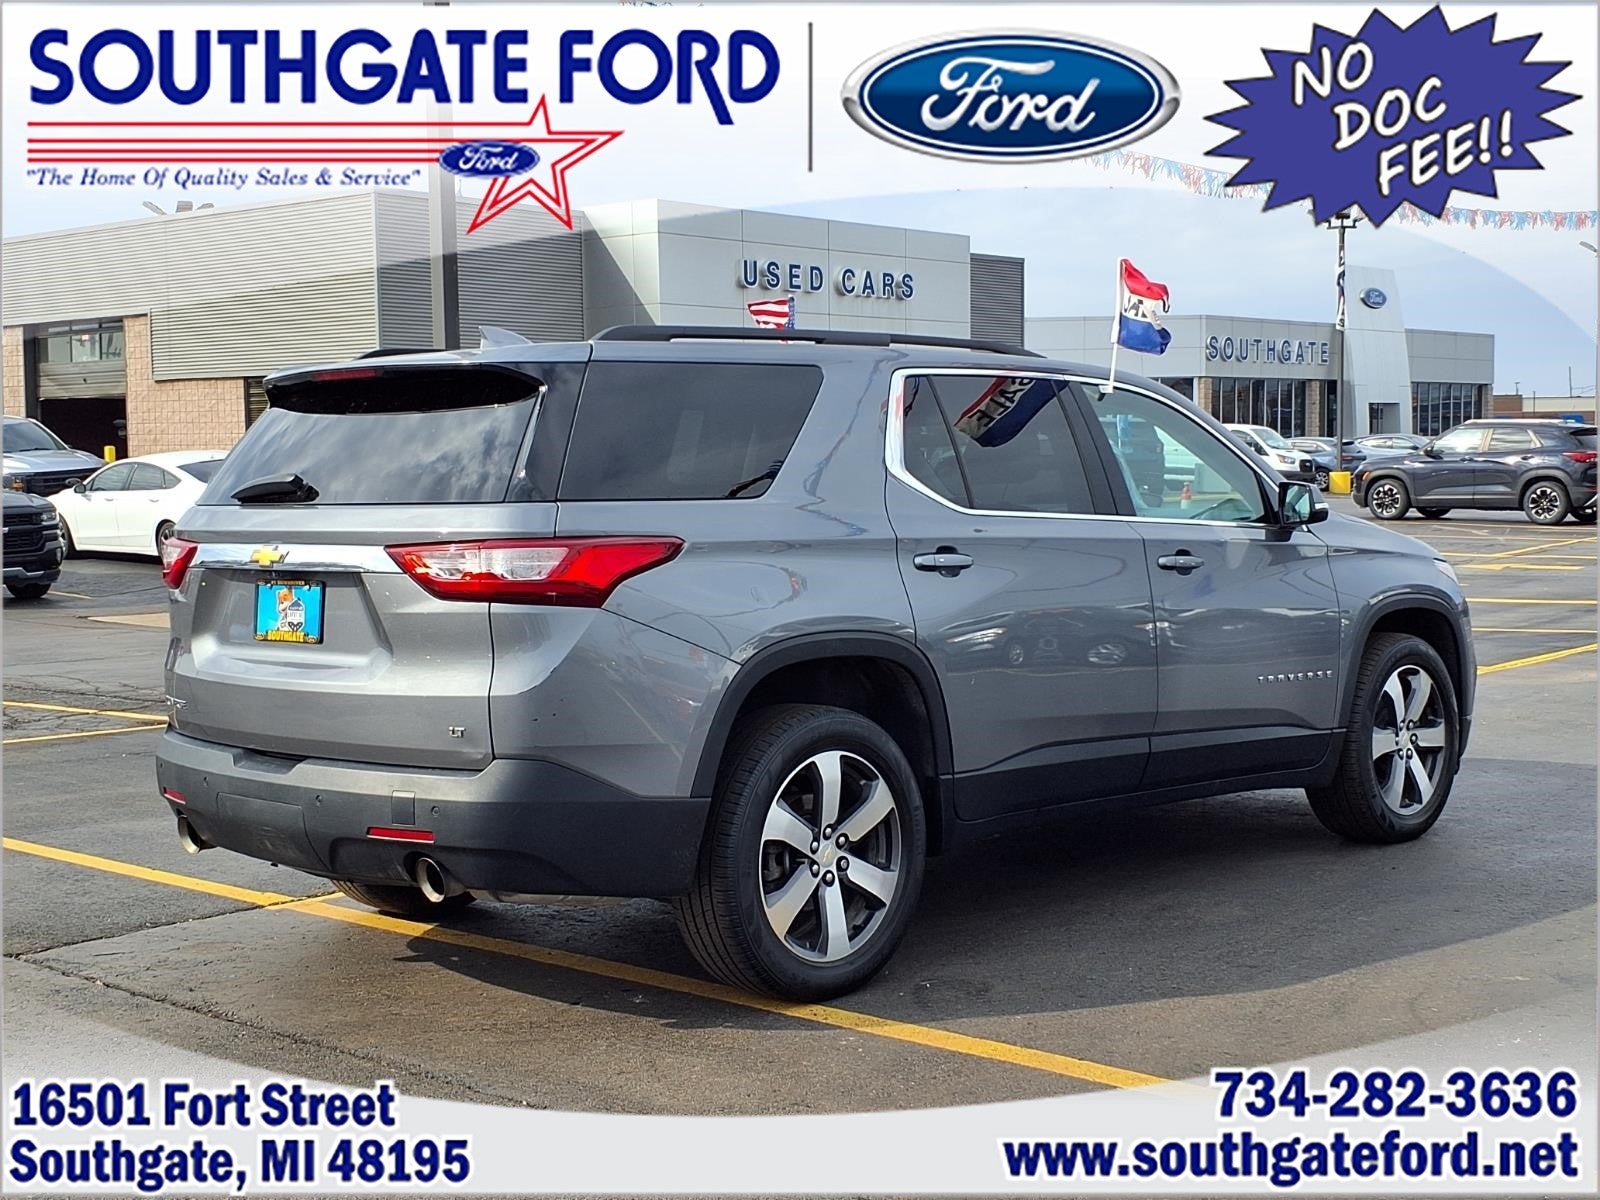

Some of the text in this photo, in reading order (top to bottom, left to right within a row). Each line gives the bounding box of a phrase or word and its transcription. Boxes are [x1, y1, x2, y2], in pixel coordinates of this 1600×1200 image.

[741, 258, 915, 300] USED CARS
[1206, 335, 1330, 365] SOUTHGATE
[267, 630, 305, 643] SOUTHGATE
[1257, 669, 1333, 684] TRAVERSE
[448, 726, 466, 738] LT
